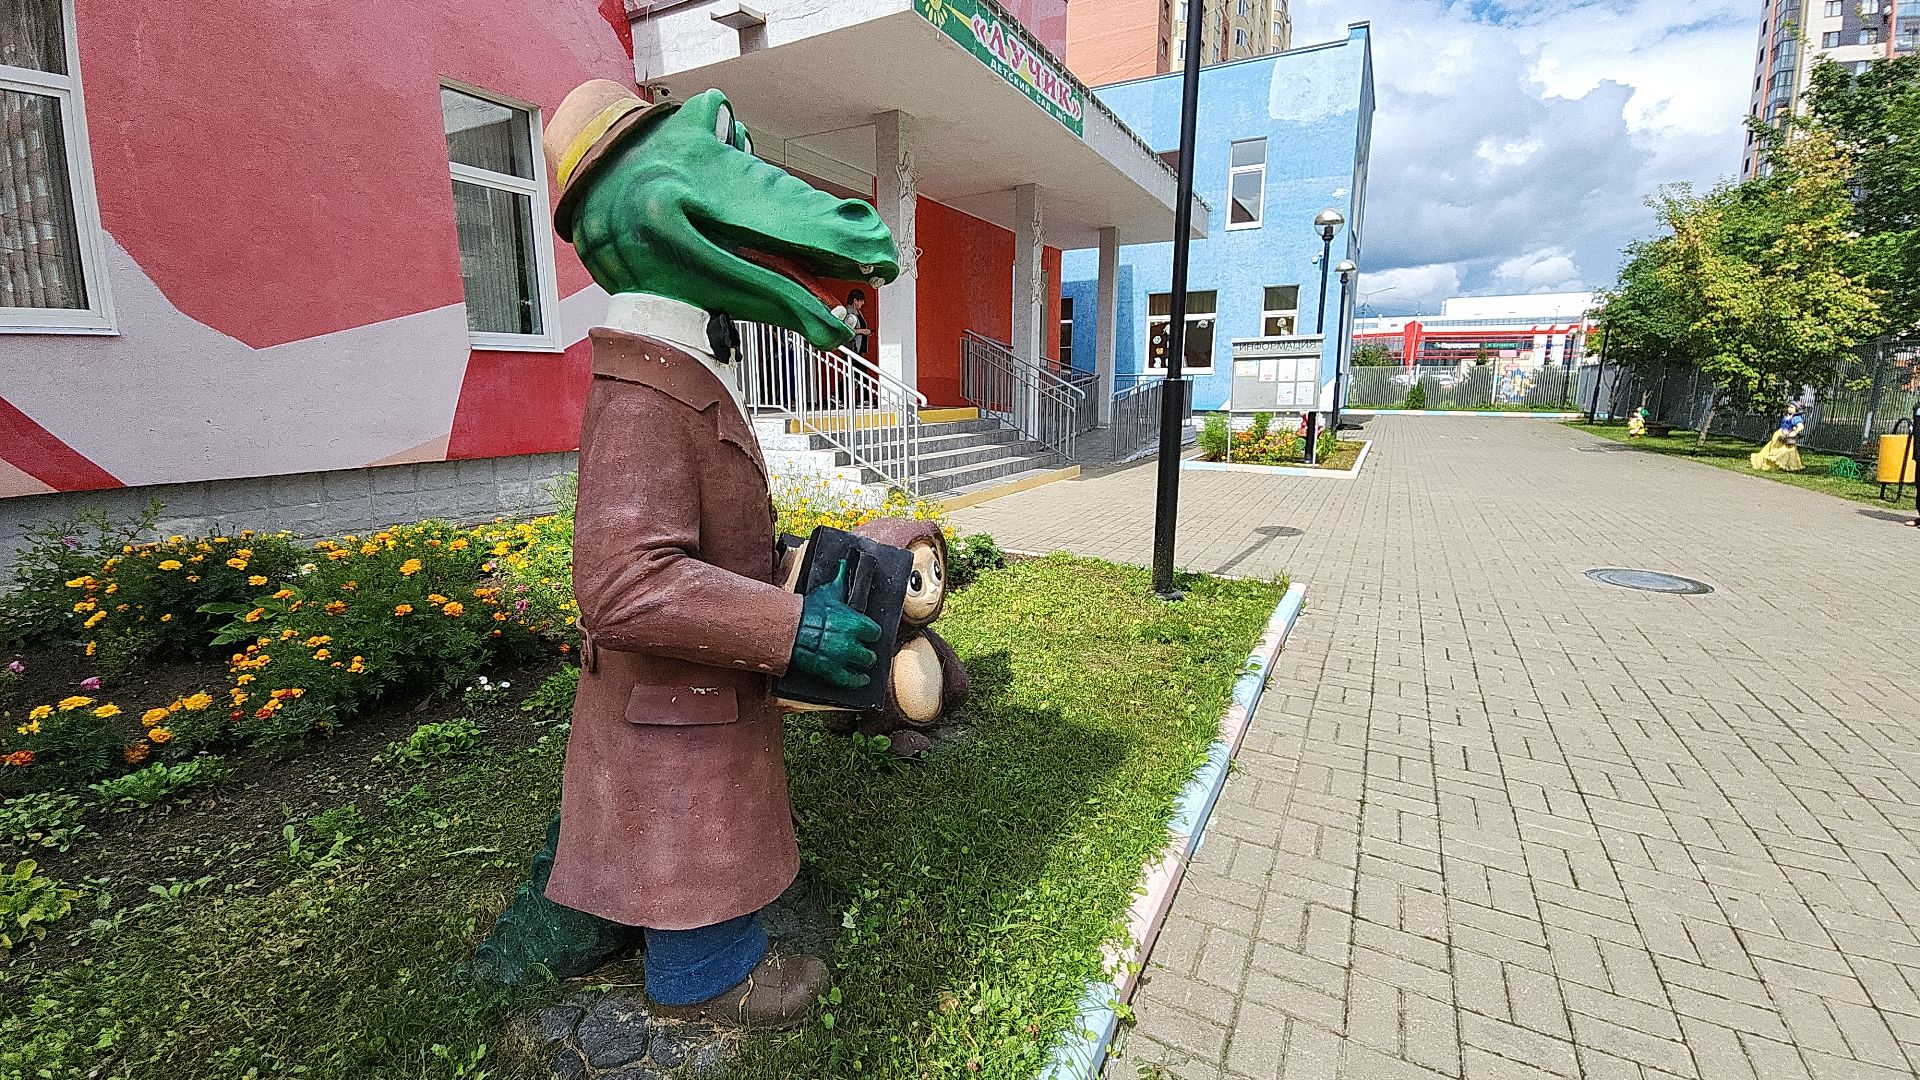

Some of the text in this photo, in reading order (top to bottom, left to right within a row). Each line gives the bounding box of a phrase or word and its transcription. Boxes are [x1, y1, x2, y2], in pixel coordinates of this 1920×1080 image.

[973, 17, 1081, 119] «ЛУЧИК»
[990, 58, 1031, 96] ДЕТСКИЙ
[1036, 94, 1051, 112] САД
[1239, 340, 1316, 352] ИНФОРМАЦИЯ
